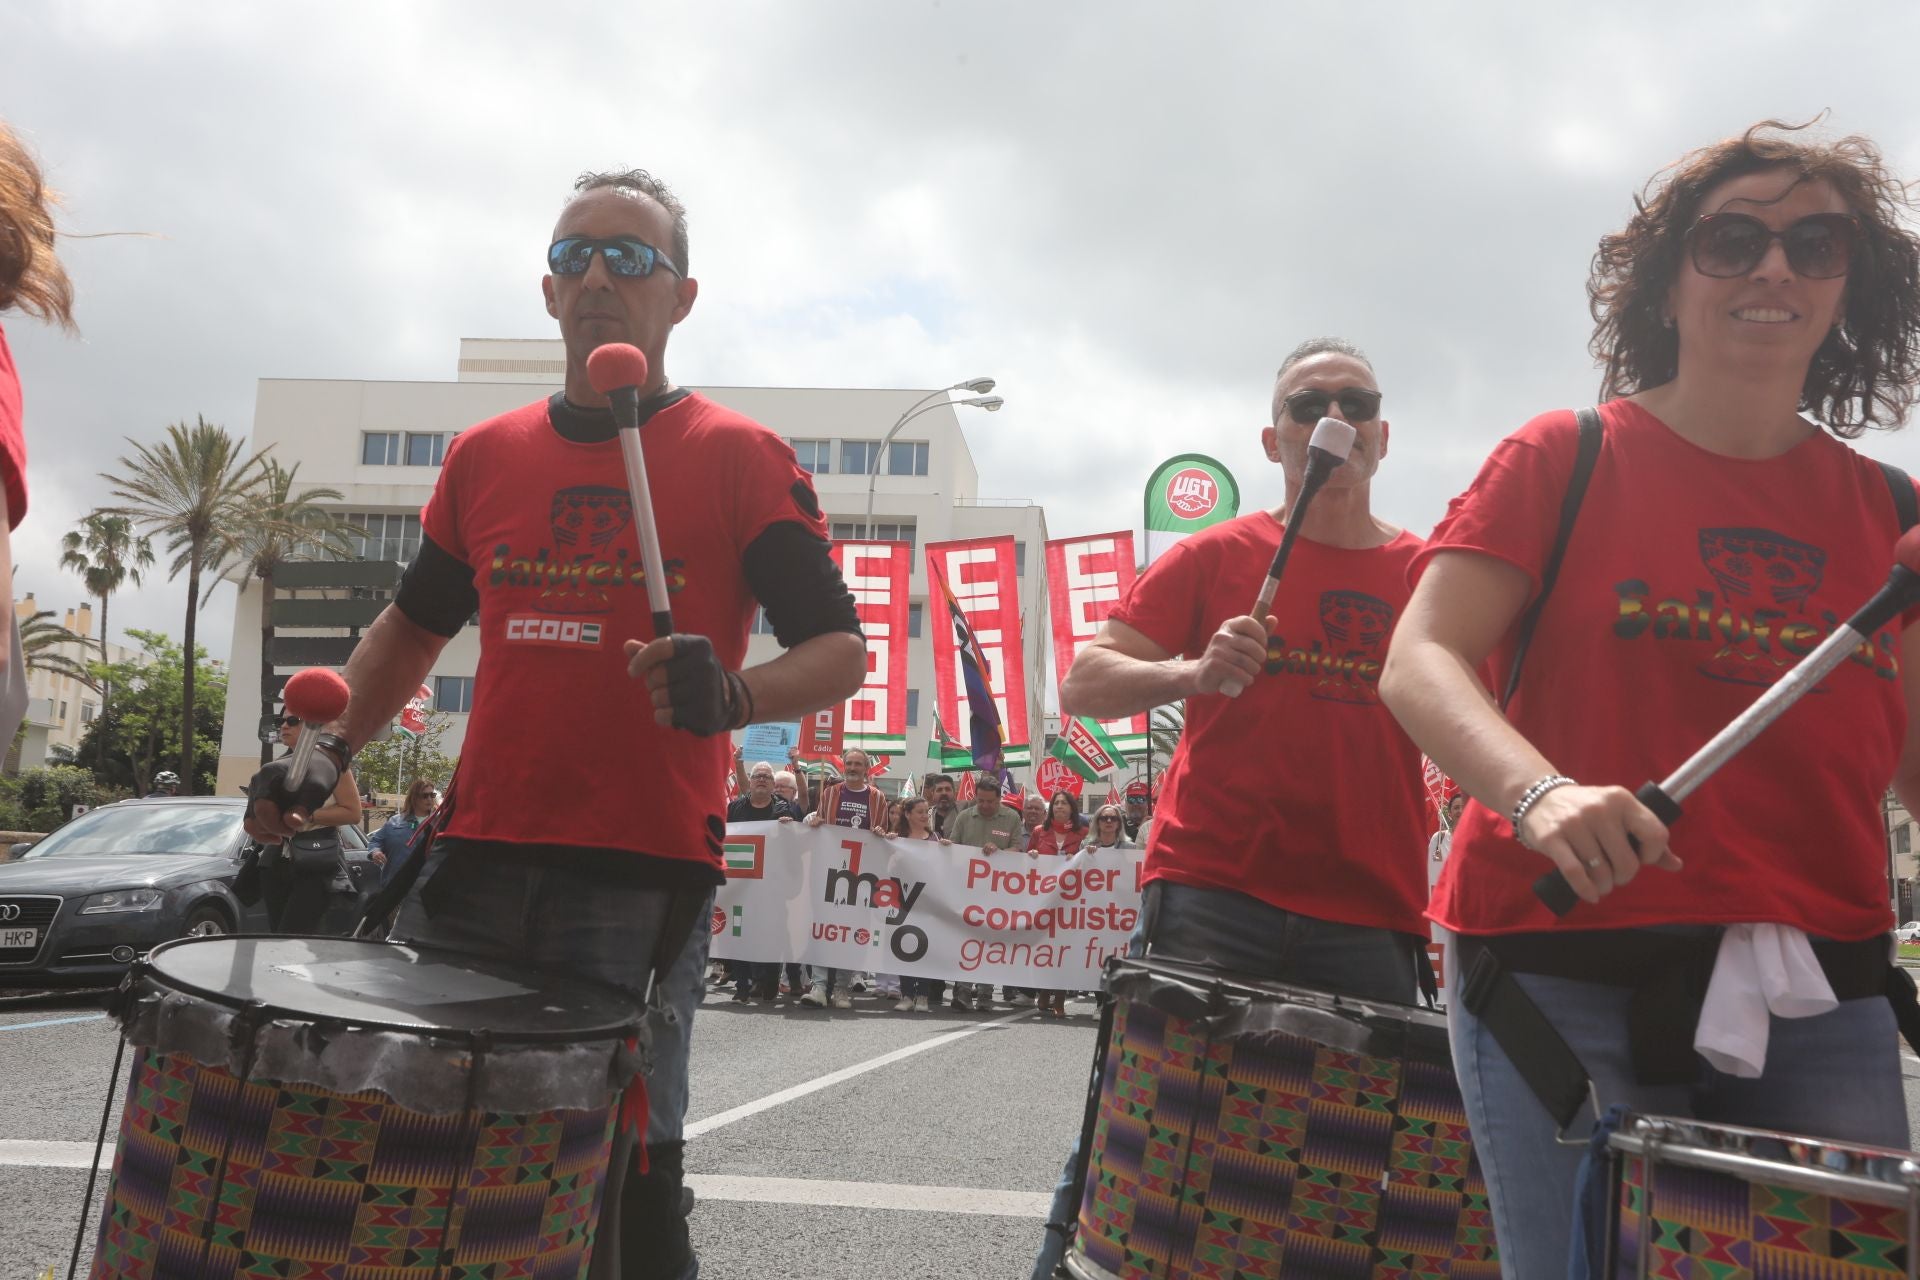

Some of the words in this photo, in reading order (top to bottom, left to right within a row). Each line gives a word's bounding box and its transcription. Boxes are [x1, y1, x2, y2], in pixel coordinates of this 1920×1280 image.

[1174, 476, 1213, 499] UGT
[506, 619, 581, 641] CCOO
[813, 744, 833, 757] Cádiz
[841, 839, 863, 875] 1
[967, 858, 1121, 900] Proteger
[962, 898, 1138, 938] conquista
[4, 931, 34, 946] HKP
[811, 922, 852, 943] UGT
[959, 938, 1072, 971] ganar
